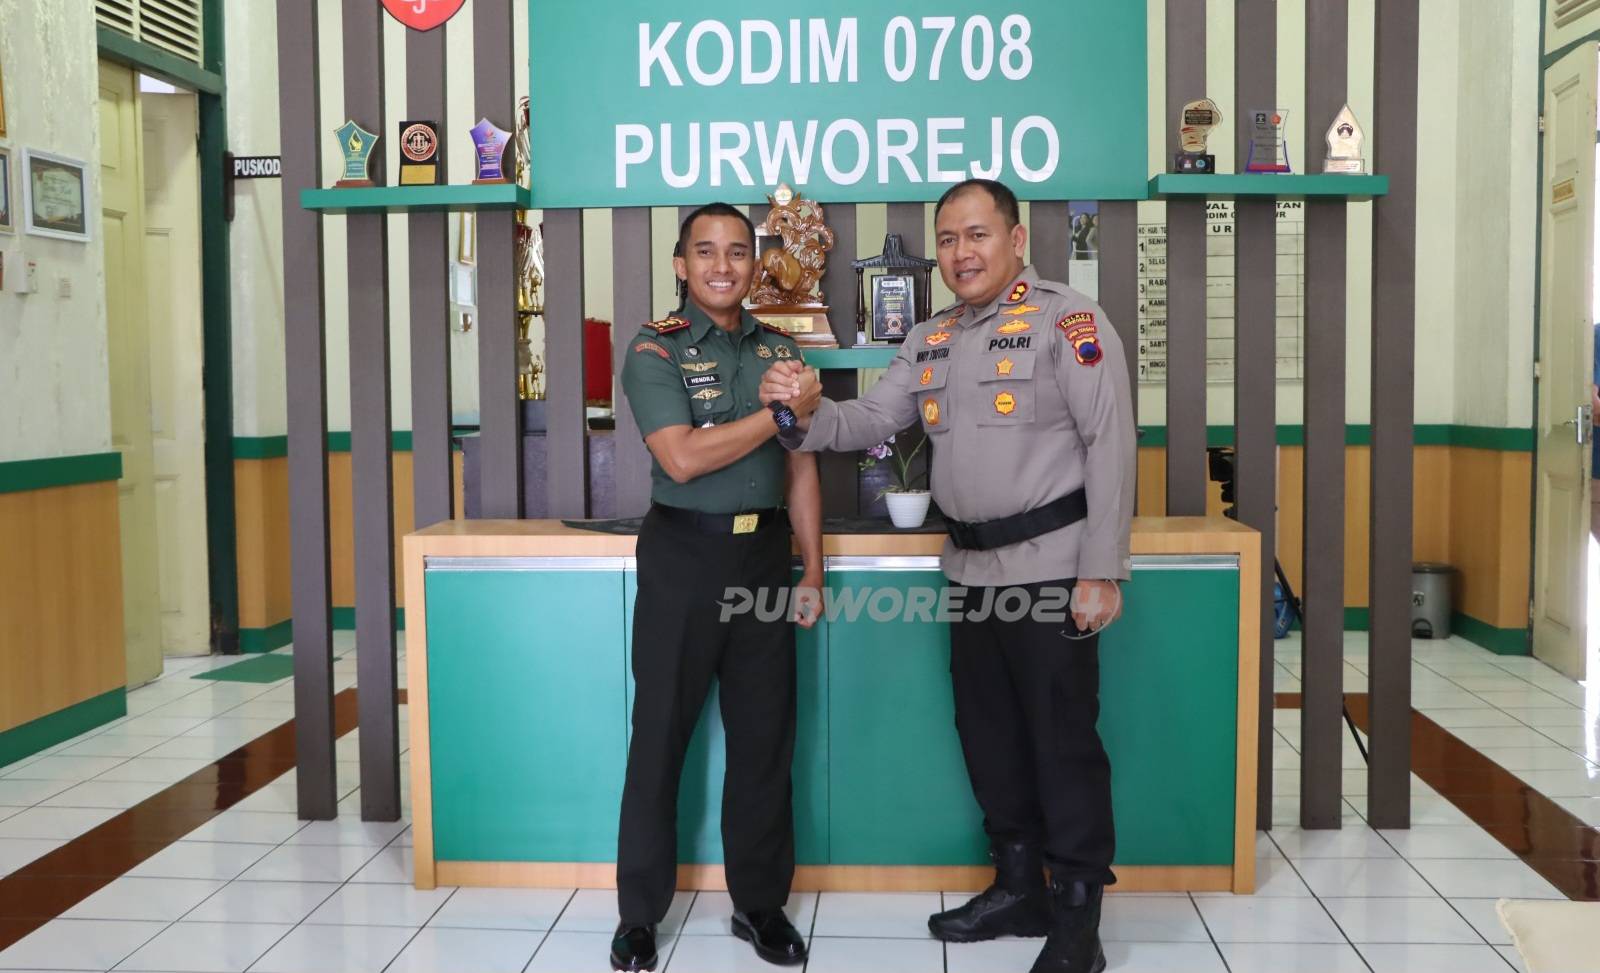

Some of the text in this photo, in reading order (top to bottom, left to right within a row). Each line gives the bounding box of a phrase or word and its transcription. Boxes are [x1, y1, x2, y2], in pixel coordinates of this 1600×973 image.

[639, 14, 1034, 87] KODIM 0708
[614, 115, 1060, 189] PURWOREJO
[1139, 243, 1144, 252] 1
[1139, 263, 1145, 272] 2
[1140, 284, 1145, 293] 3
[1140, 305, 1145, 313] 4
[1140, 325, 1145, 334] 5
[989, 336, 1032, 351] POLRI
[1140, 346, 1145, 354] 6
[1140, 366, 1146, 375] 7
